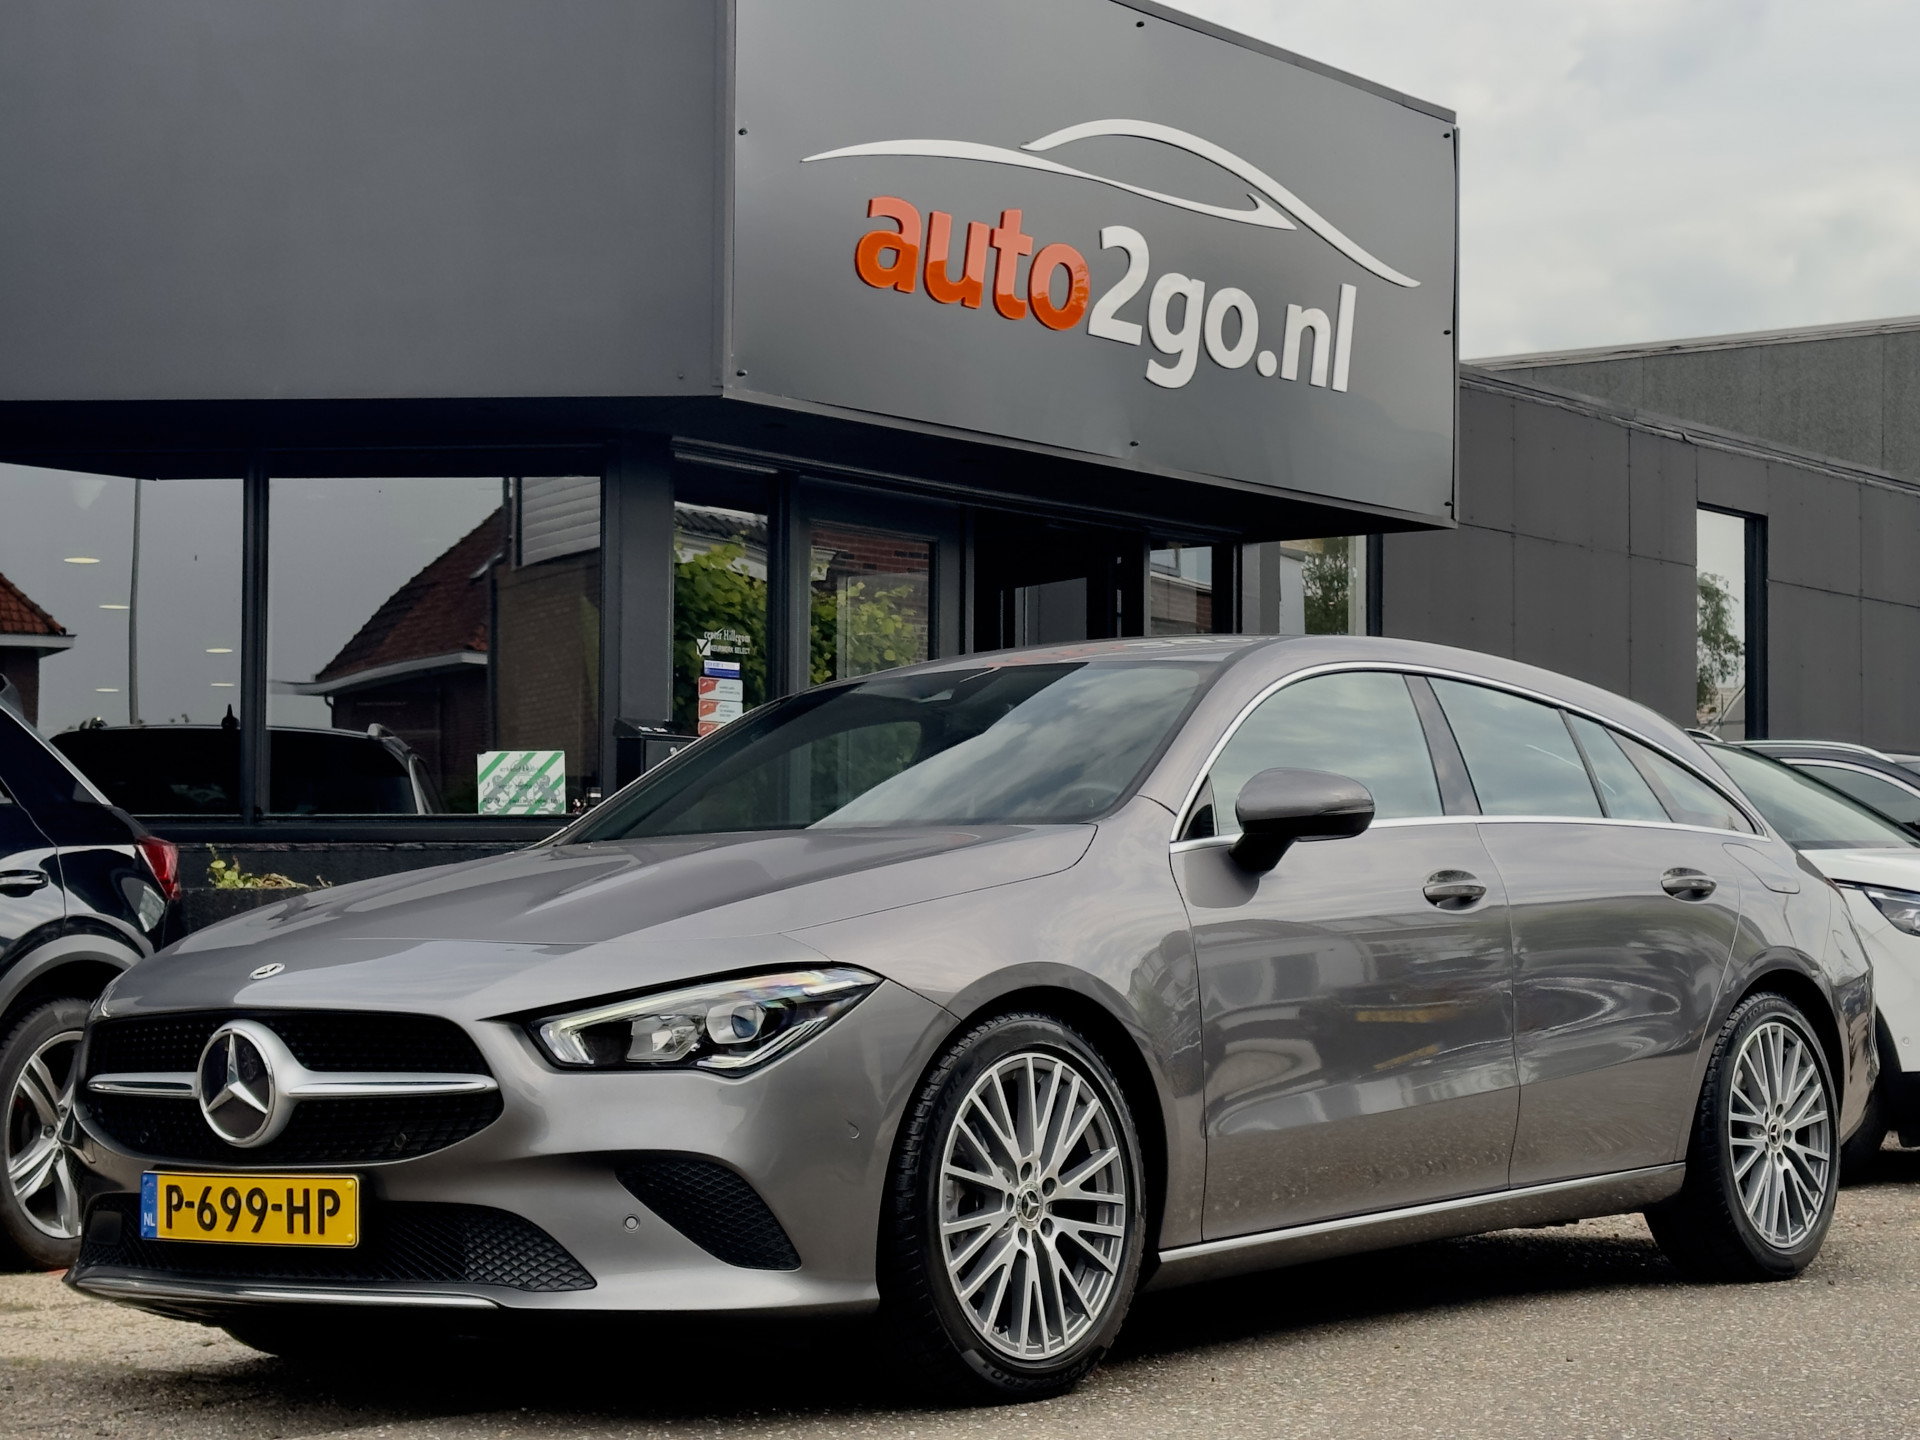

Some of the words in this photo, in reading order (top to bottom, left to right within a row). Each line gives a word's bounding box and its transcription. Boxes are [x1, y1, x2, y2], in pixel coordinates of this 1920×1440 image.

[855, 195, 1357, 393] auto2go.nl
[143, 1212, 156, 1227] NL
[165, 1184, 341, 1235] P-699-HP
